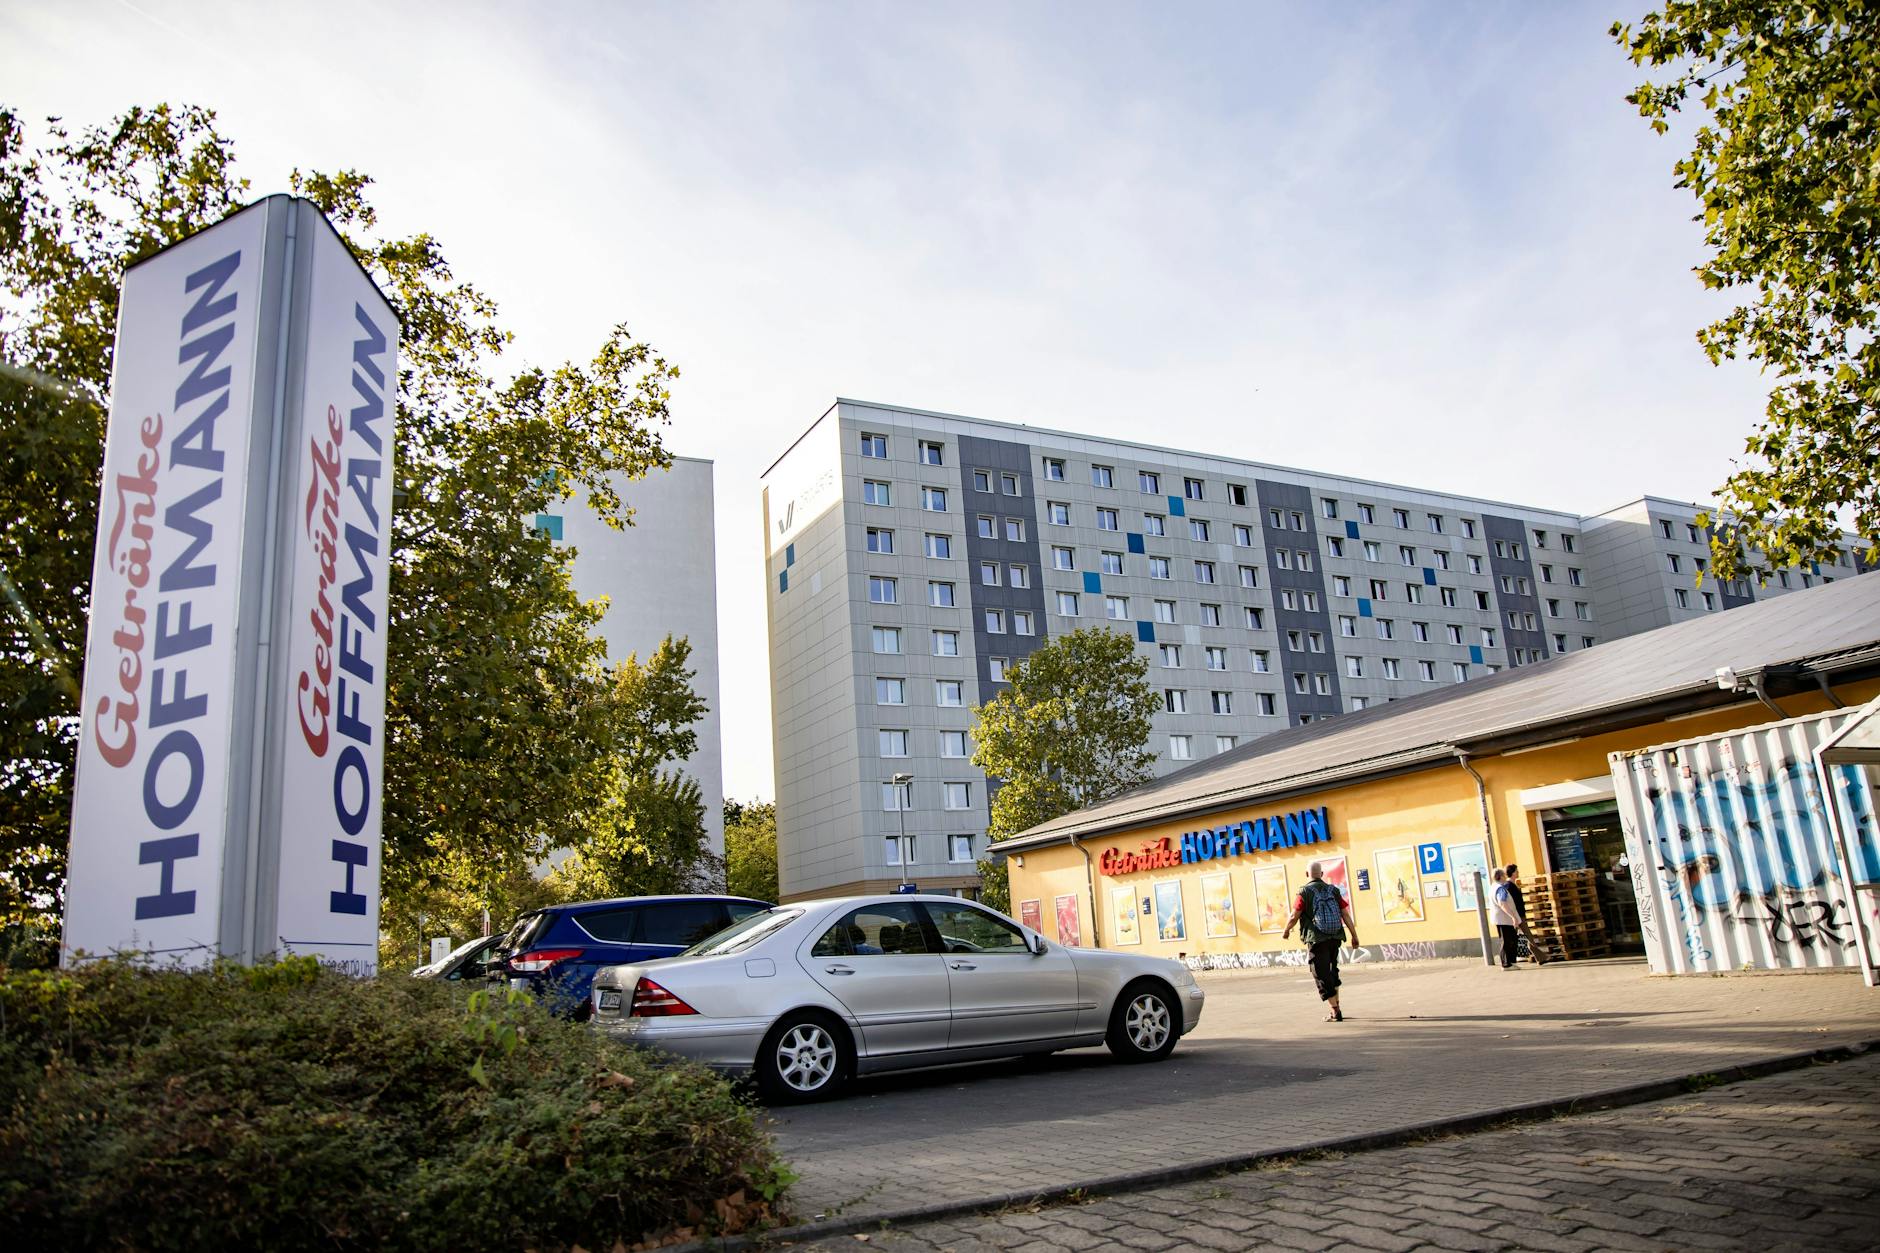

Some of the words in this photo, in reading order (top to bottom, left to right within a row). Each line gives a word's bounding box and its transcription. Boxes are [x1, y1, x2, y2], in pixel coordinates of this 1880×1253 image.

[96, 414, 163, 768] Getränke
[135, 250, 241, 920] HOFFMANN
[298, 404, 343, 757] Getränke
[330, 302, 387, 915] HOFFMANN
[1100, 837, 1182, 876] Getränke
[1180, 806, 1331, 865] HOFFMANN
[1379, 941, 1437, 961] BRONSON
[1423, 846, 1438, 871] P
